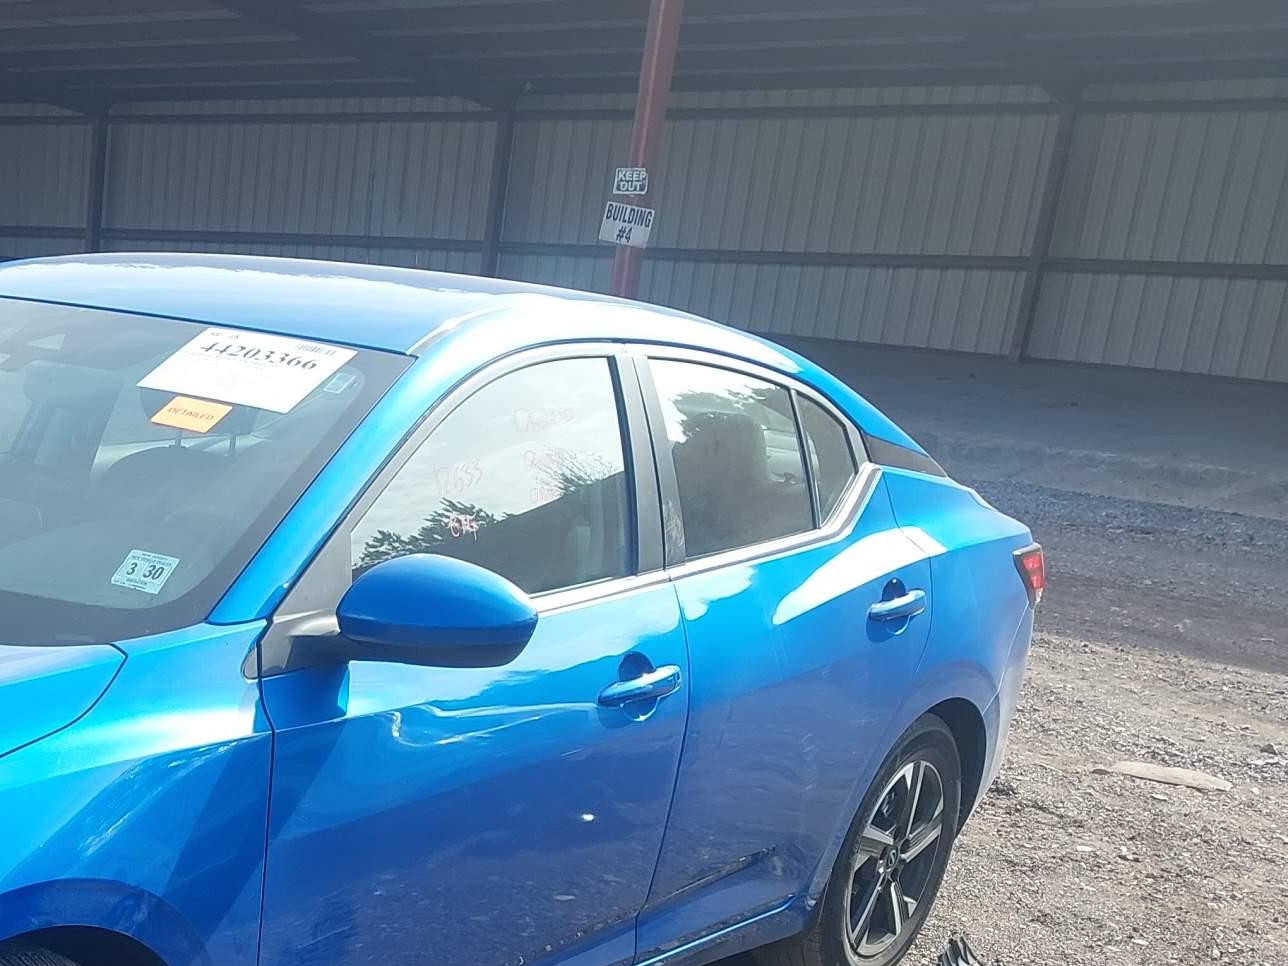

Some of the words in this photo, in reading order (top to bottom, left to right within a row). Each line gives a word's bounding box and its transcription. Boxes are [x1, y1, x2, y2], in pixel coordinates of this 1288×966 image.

[617, 171, 647, 180] KEEP
[619, 181, 643, 191] OUT
[605, 203, 653, 228] BUILDING
[616, 225, 633, 243] #4
[200, 342, 317, 370] 44203366
[126, 562, 138, 575] 3
[143, 564, 165, 580] 30
